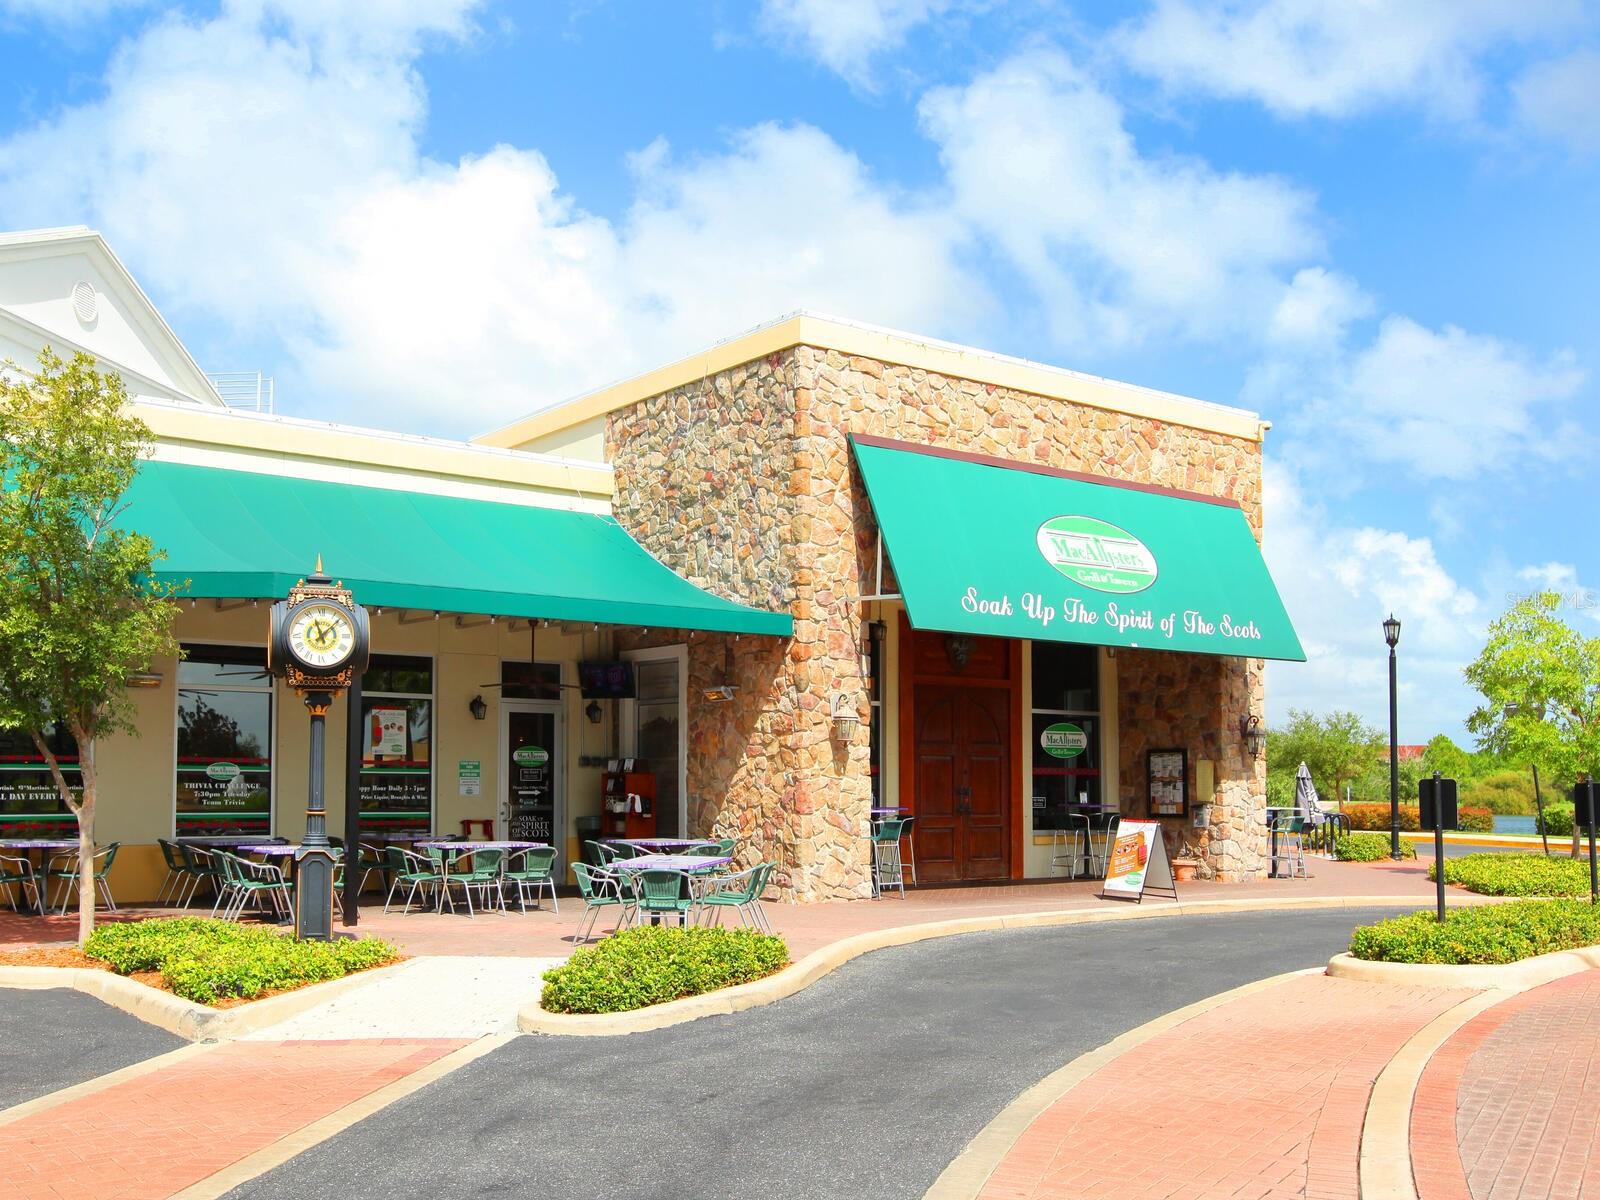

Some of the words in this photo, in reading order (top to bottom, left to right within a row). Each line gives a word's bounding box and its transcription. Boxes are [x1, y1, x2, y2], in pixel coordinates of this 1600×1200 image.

[961, 586, 1014, 616] Soak
[1021, 592, 1055, 627] Up
[1063, 597, 1099, 625] The
[1104, 601, 1154, 634] Spirit
[1160, 612, 1176, 639] of
[1183, 609, 1216, 636] The
[1219, 613, 1262, 640] Scots
[521, 821, 550, 830] SPIRIT
[521, 830, 550, 838] SCOTS
